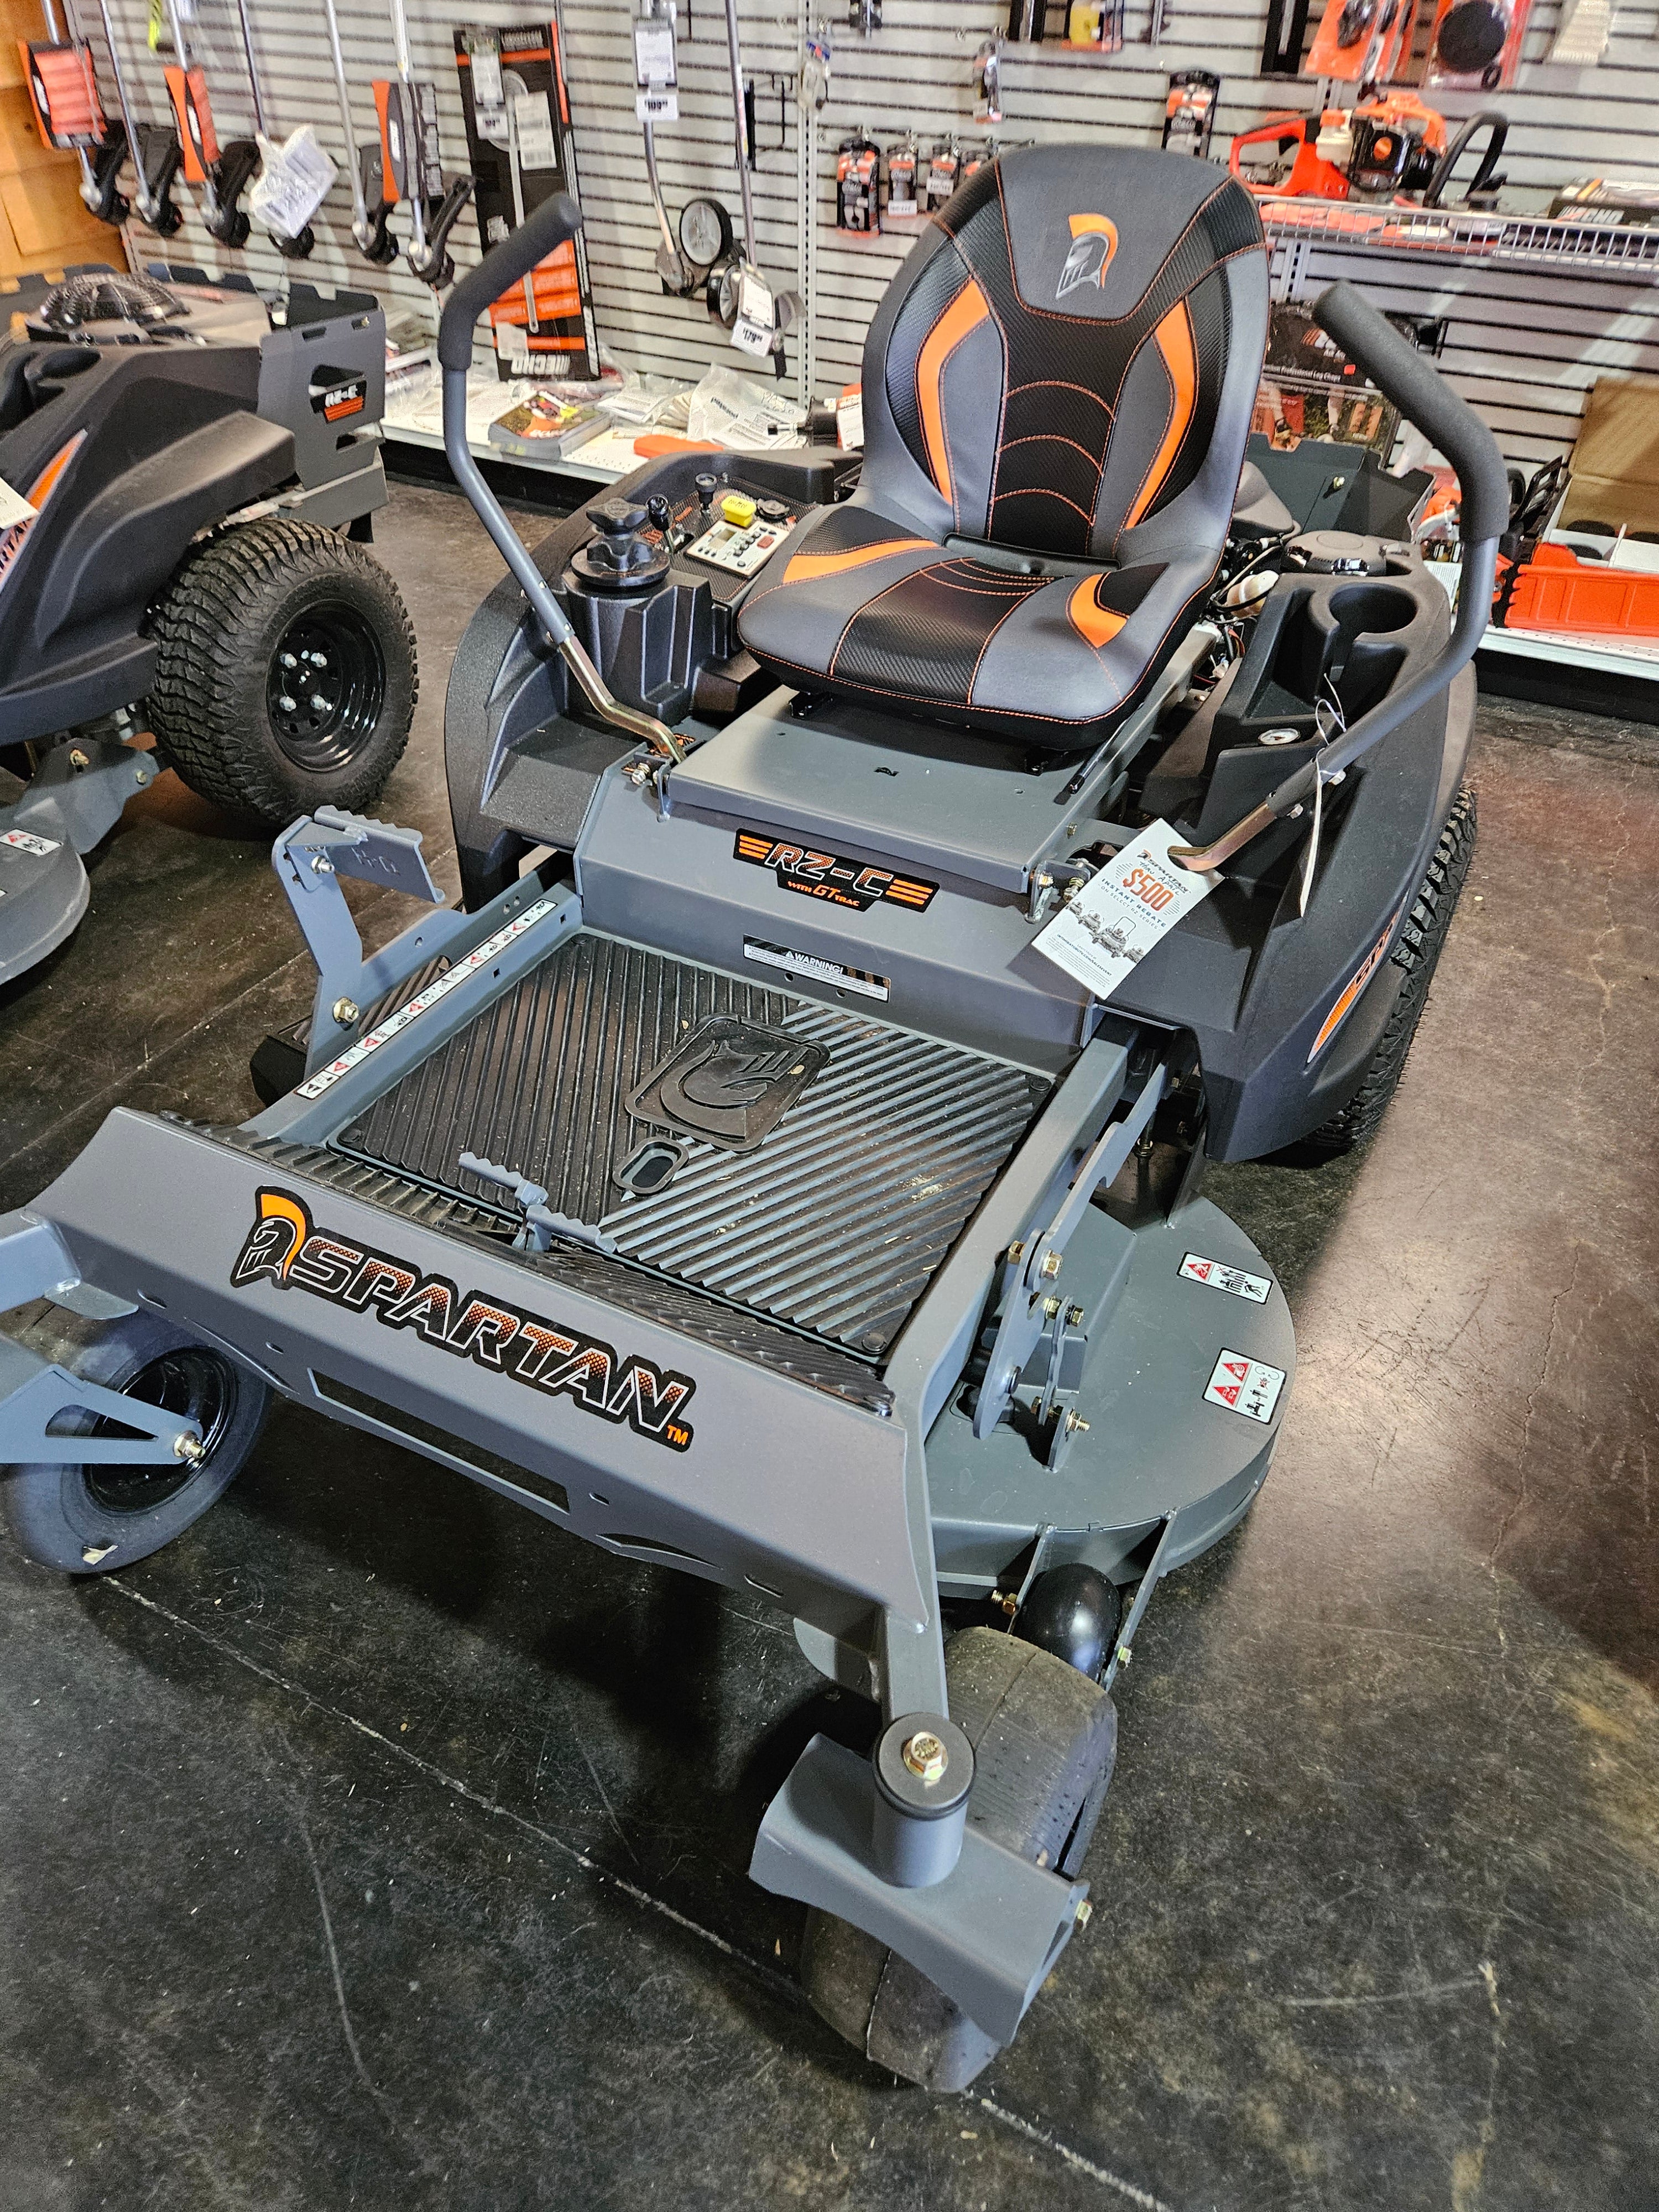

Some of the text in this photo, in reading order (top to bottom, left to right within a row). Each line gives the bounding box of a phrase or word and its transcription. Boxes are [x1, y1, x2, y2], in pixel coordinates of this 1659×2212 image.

[511, 354, 556, 374] ECHO
[764, 843, 894, 896] RZ-C
[1123, 868, 1174, 911] $500
[1147, 858, 1189, 894] SPARTAN
[1102, 878, 1167, 928] INSTANT REBATE
[1110, 893, 1130, 908] SELECT
[1138, 914, 1158, 930] SERIES
[795, 953, 843, 974] WARNING!
[290, 1237, 690, 1446] SPARTAN TM
